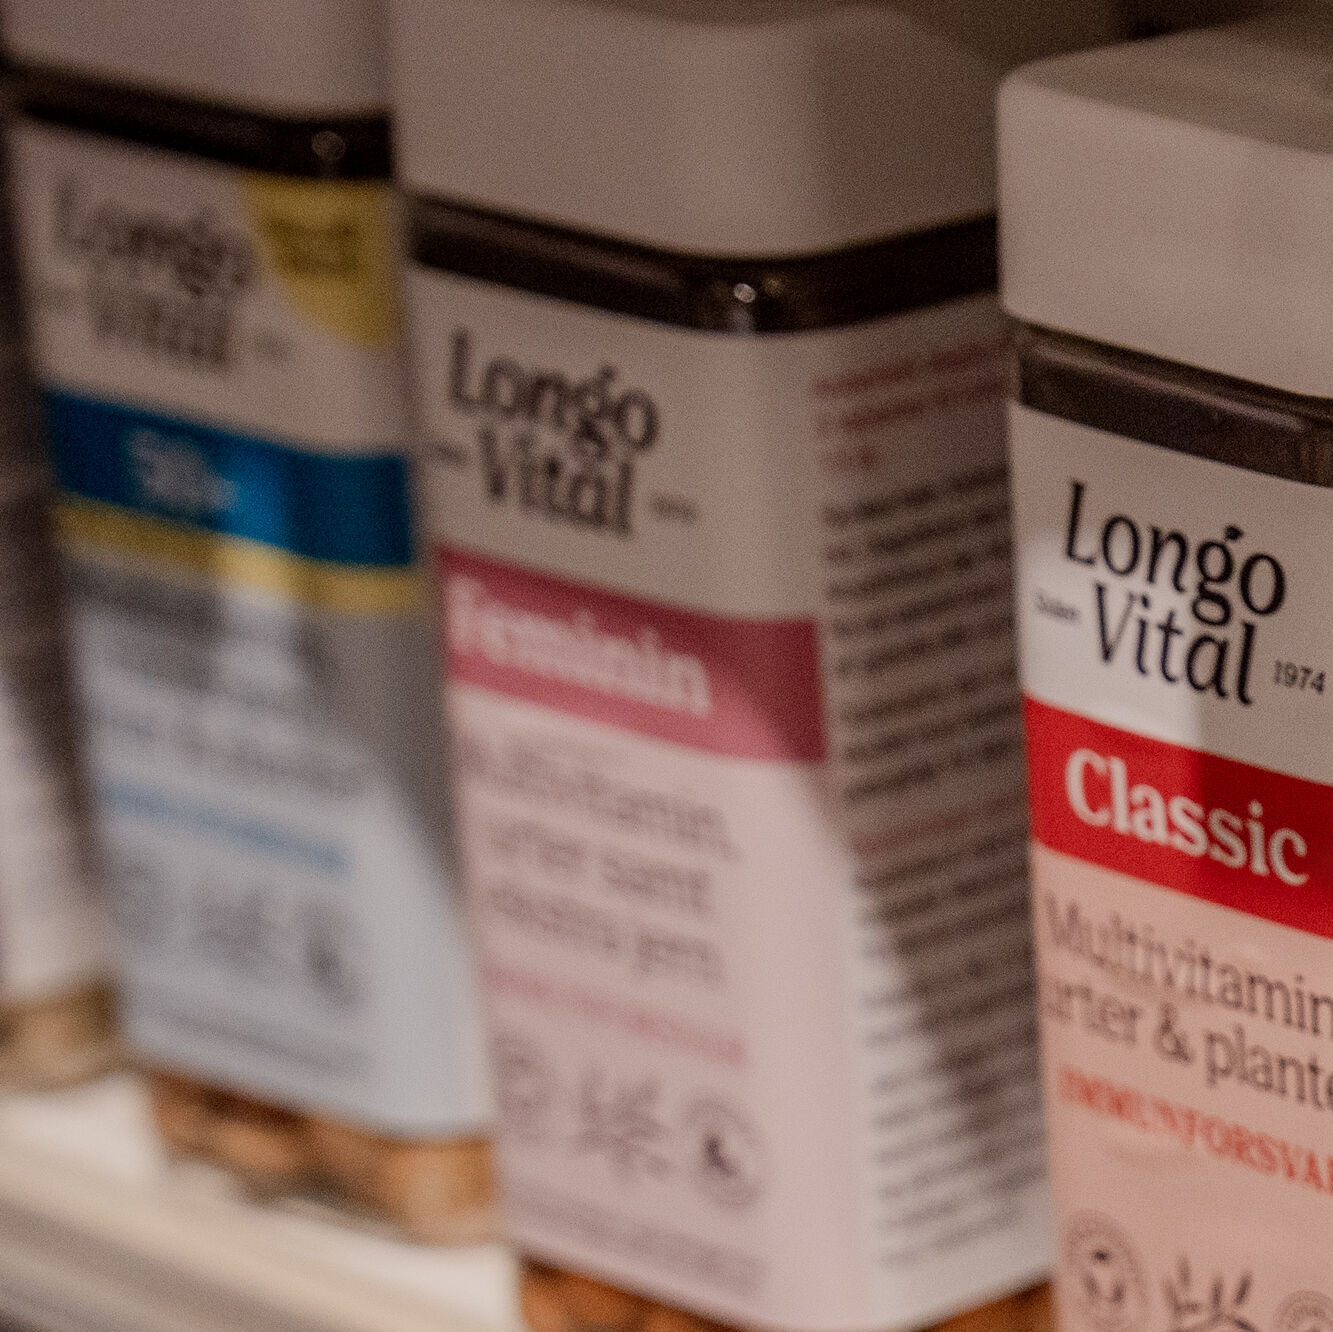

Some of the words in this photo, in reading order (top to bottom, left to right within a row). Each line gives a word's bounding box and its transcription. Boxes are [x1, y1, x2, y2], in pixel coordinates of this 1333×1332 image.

[448, 326, 660, 460] Longo
[480, 428, 635, 538] Vital
[1065, 481, 1288, 628] Longo
[1095, 583, 1255, 705] Vital
[1273, 659, 1328, 695] 1974
[1066, 748, 1310, 887] Classic
[1154, 1000, 1193, 1066] &
